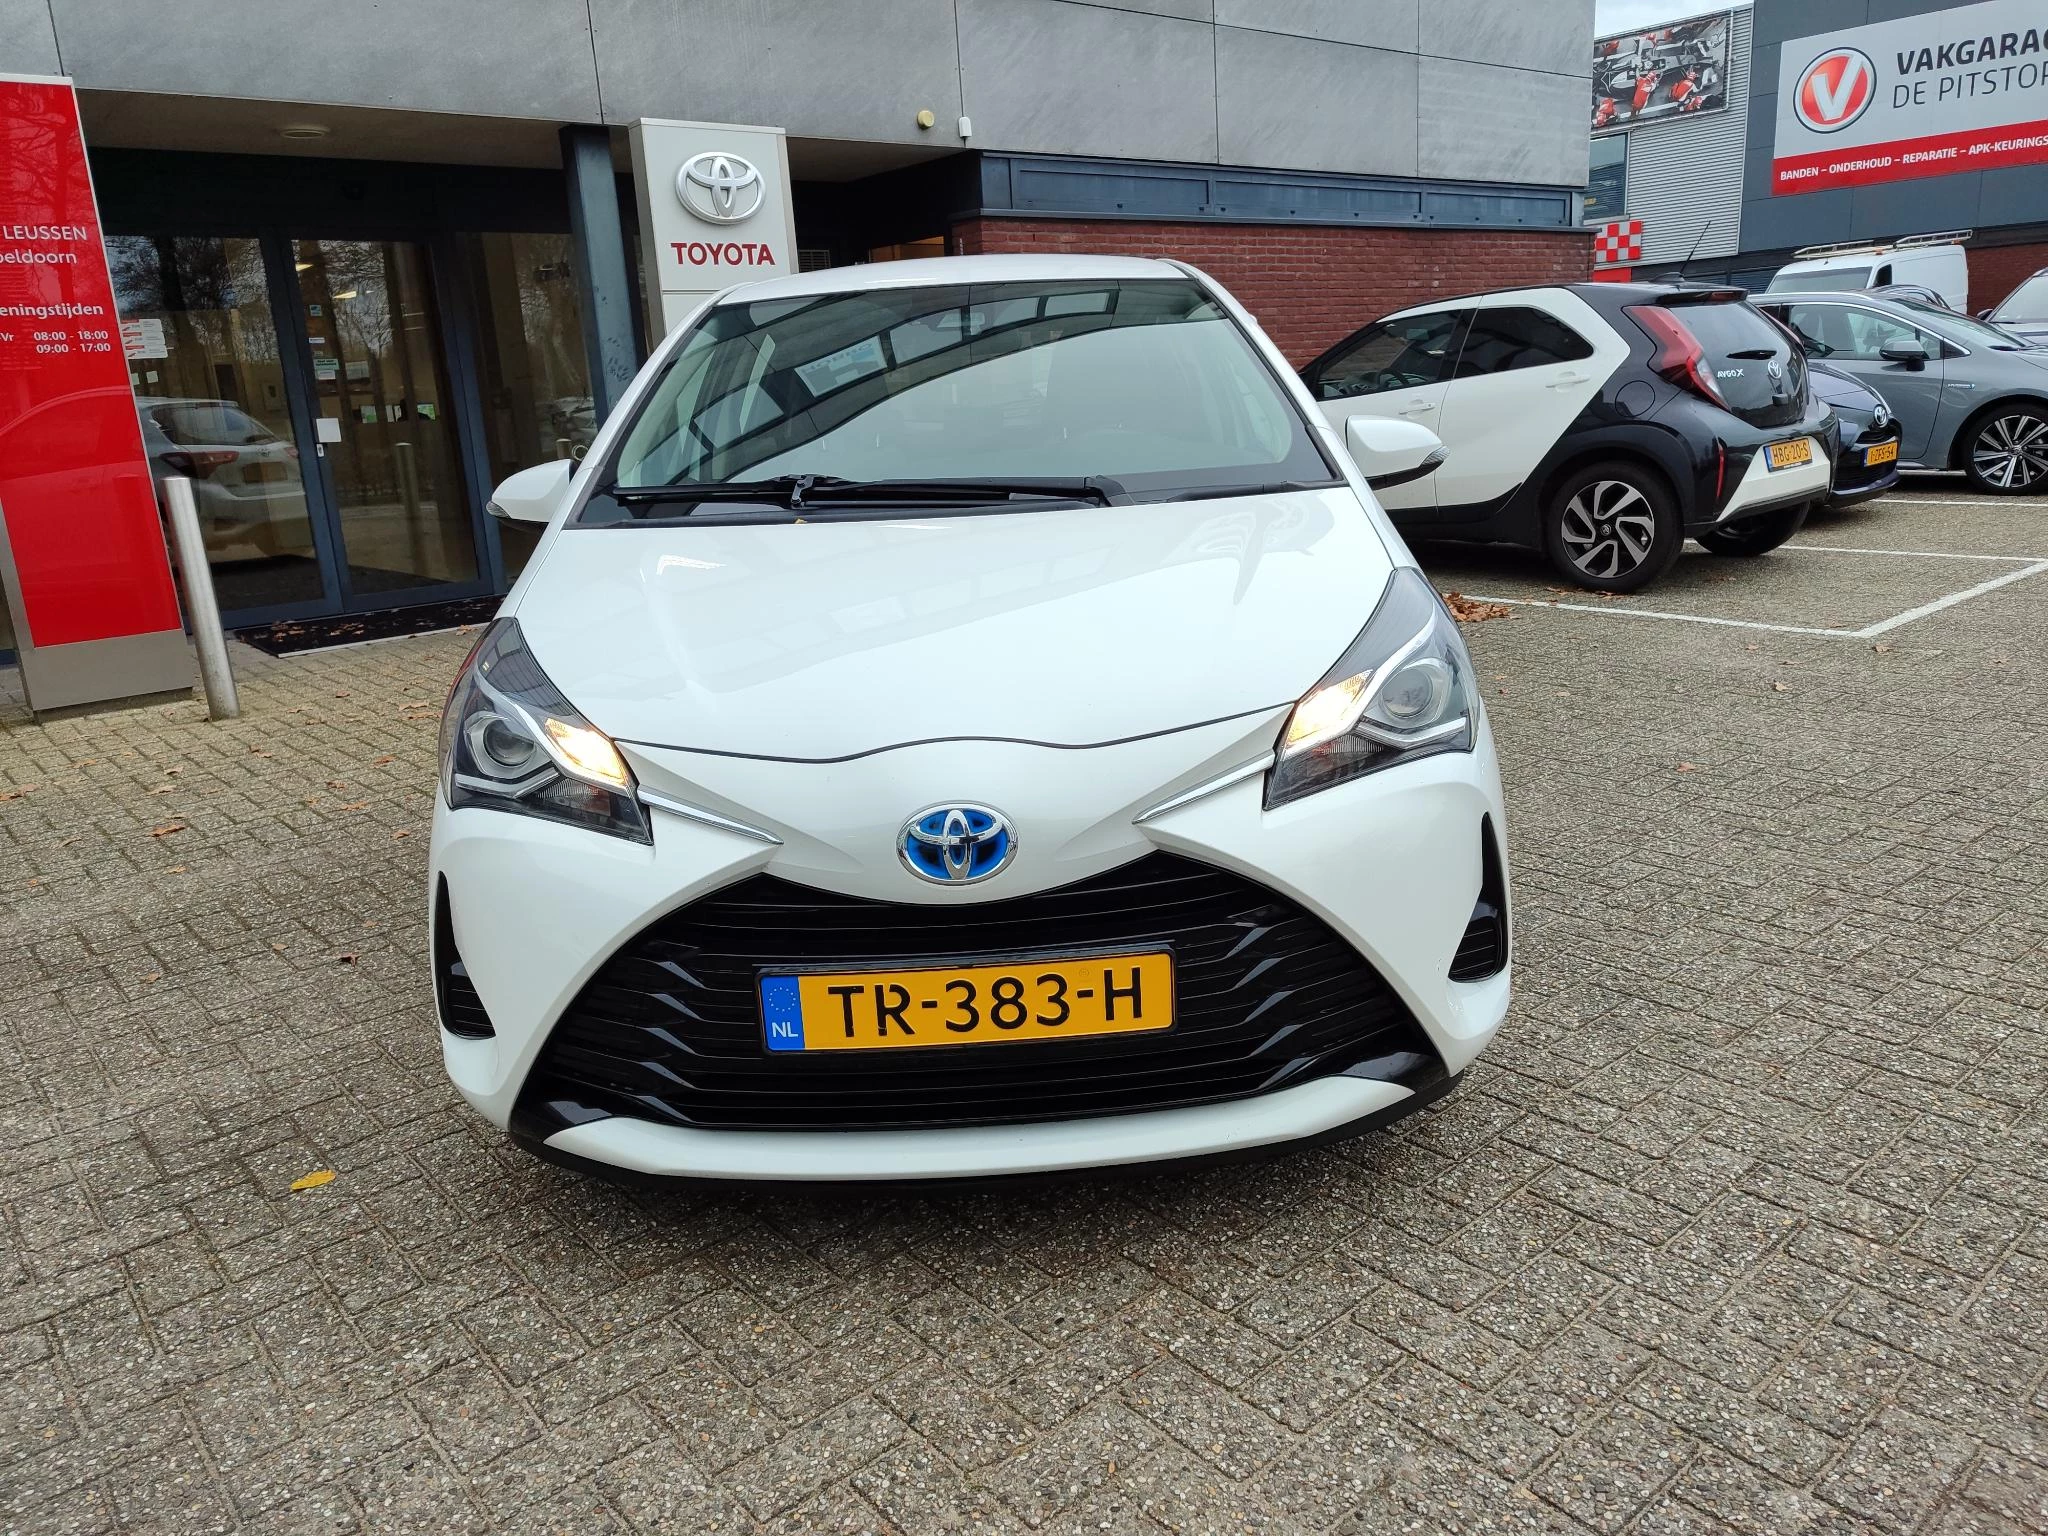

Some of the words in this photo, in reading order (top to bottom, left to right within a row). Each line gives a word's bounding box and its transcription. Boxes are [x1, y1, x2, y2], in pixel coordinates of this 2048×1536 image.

[1897, 27, 2048, 75] VAKGARA
[1893, 81, 1927, 109] DE
[1780, 166, 1819, 181] BANDEN
[1829, 156, 1892, 174] ONDERHOUD
[1903, 148, 1958, 164] REPARATIE
[3, 225, 87, 240] LEUSSEN
[670, 242, 776, 266] TOYOTA
[33, 331, 67, 341] 08:00
[77, 330, 109, 340] 18:00
[36, 343, 69, 354] 09:00
[80, 342, 112, 353] 17:00
[1772, 441, 1809, 465] HBG-20-S
[828, 966, 1142, 1038] TR-383-H
[771, 1022, 799, 1038] NL
